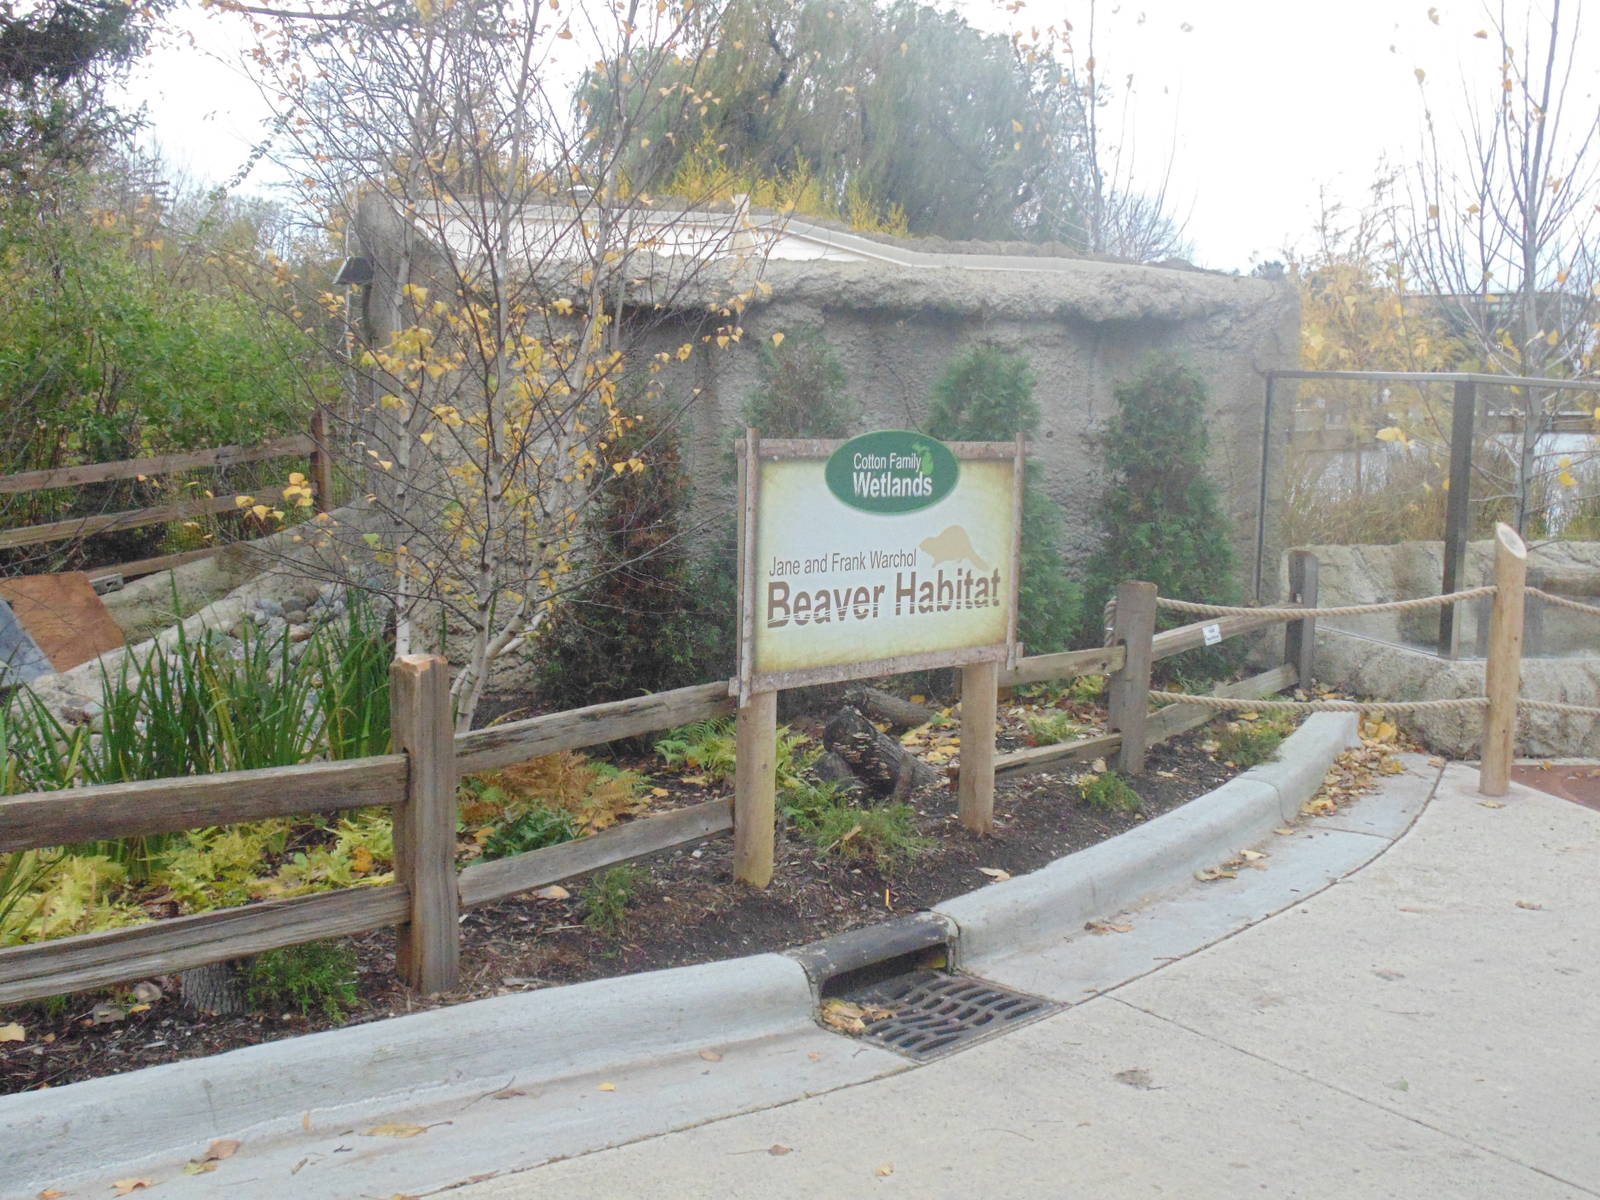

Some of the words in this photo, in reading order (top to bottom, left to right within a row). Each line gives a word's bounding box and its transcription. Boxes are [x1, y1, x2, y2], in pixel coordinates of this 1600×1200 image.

[853, 452, 887, 470] Cotton
[889, 452, 922, 473] Family
[852, 471, 933, 498] Wetlands
[769, 556, 800, 577] Jane
[804, 553, 828, 574] and
[831, 552, 866, 573] Frank
[869, 549, 917, 570] Warchol
[767, 581, 886, 629] Beaver
[895, 568, 1001, 616] Habitat
